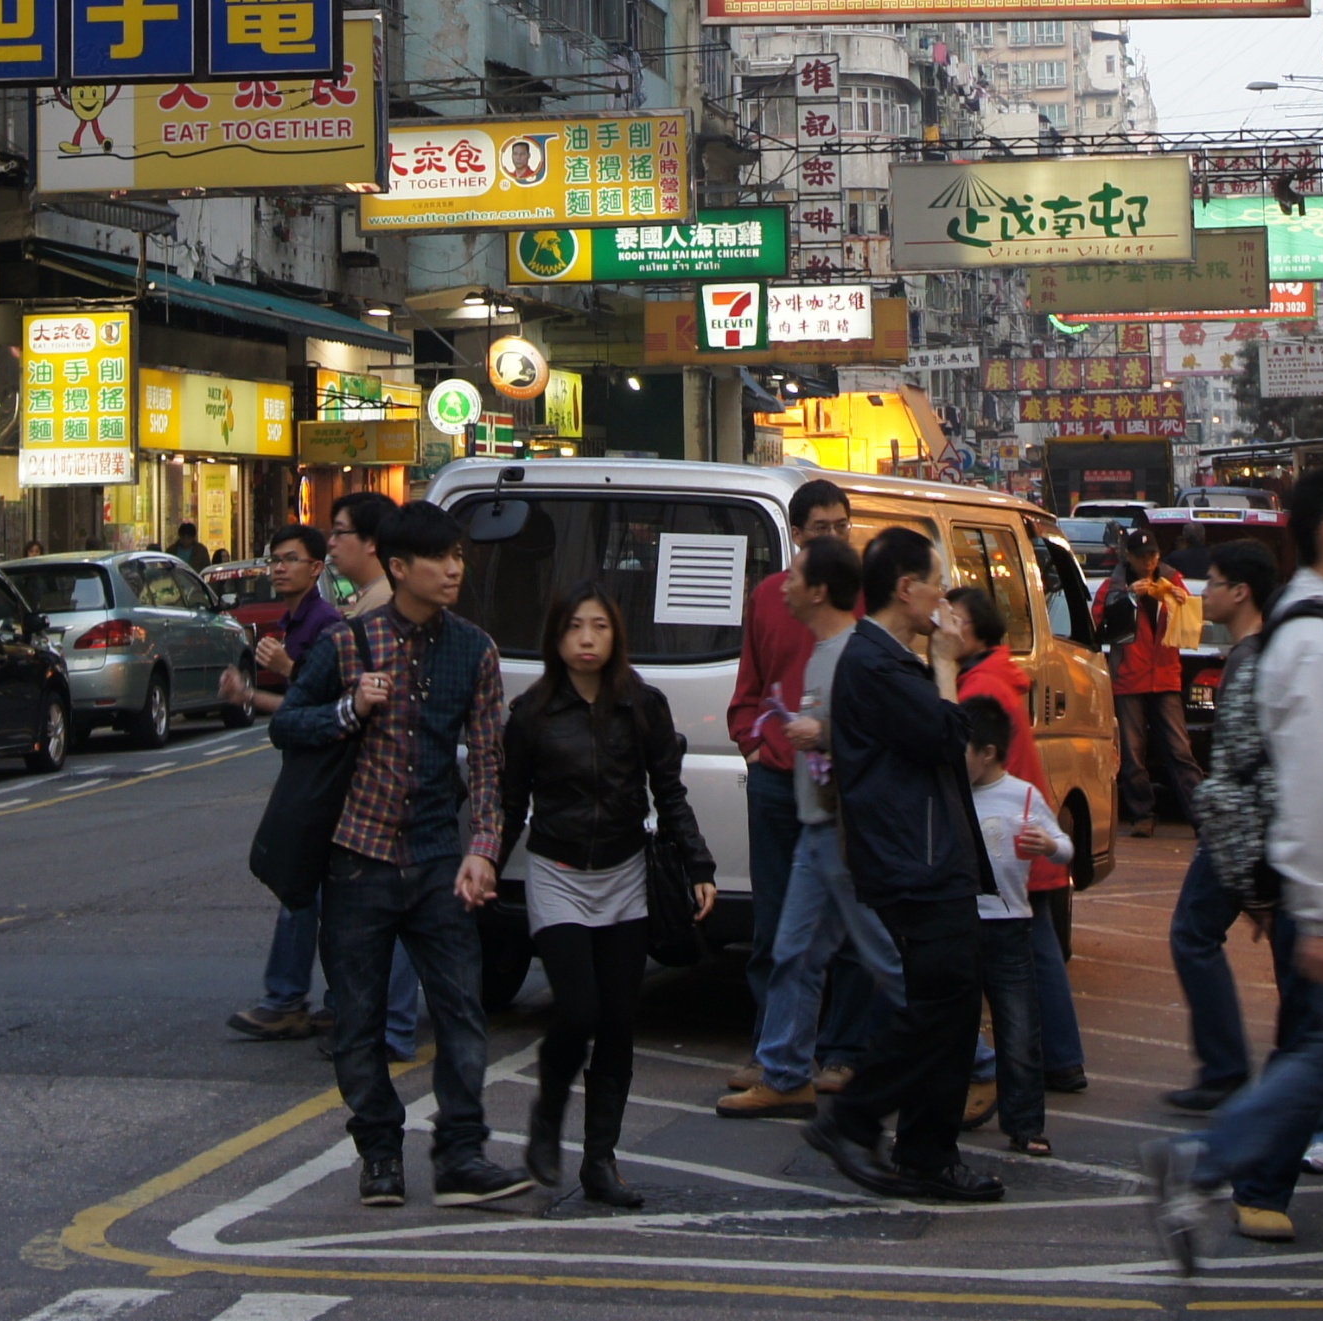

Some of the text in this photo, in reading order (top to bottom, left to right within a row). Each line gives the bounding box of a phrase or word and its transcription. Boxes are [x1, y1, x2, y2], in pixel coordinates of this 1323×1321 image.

[163, 118, 354, 143] EAT TOGETHER
[410, 176, 488, 190] TOGETHER
[368, 207, 555, 226] www.eattogether.com.hk
[615, 221, 763, 250] 泰國人海南雞
[618, 251, 645, 261] KOON
[647, 251, 670, 260] THAI
[717, 248, 760, 258] CHICKEN
[988, 243, 1156, 258] Vietnam Village
[33, 322, 91, 342] 大家食
[149, 414, 168, 434] SHOP
[267, 423, 283, 442] SHOP
